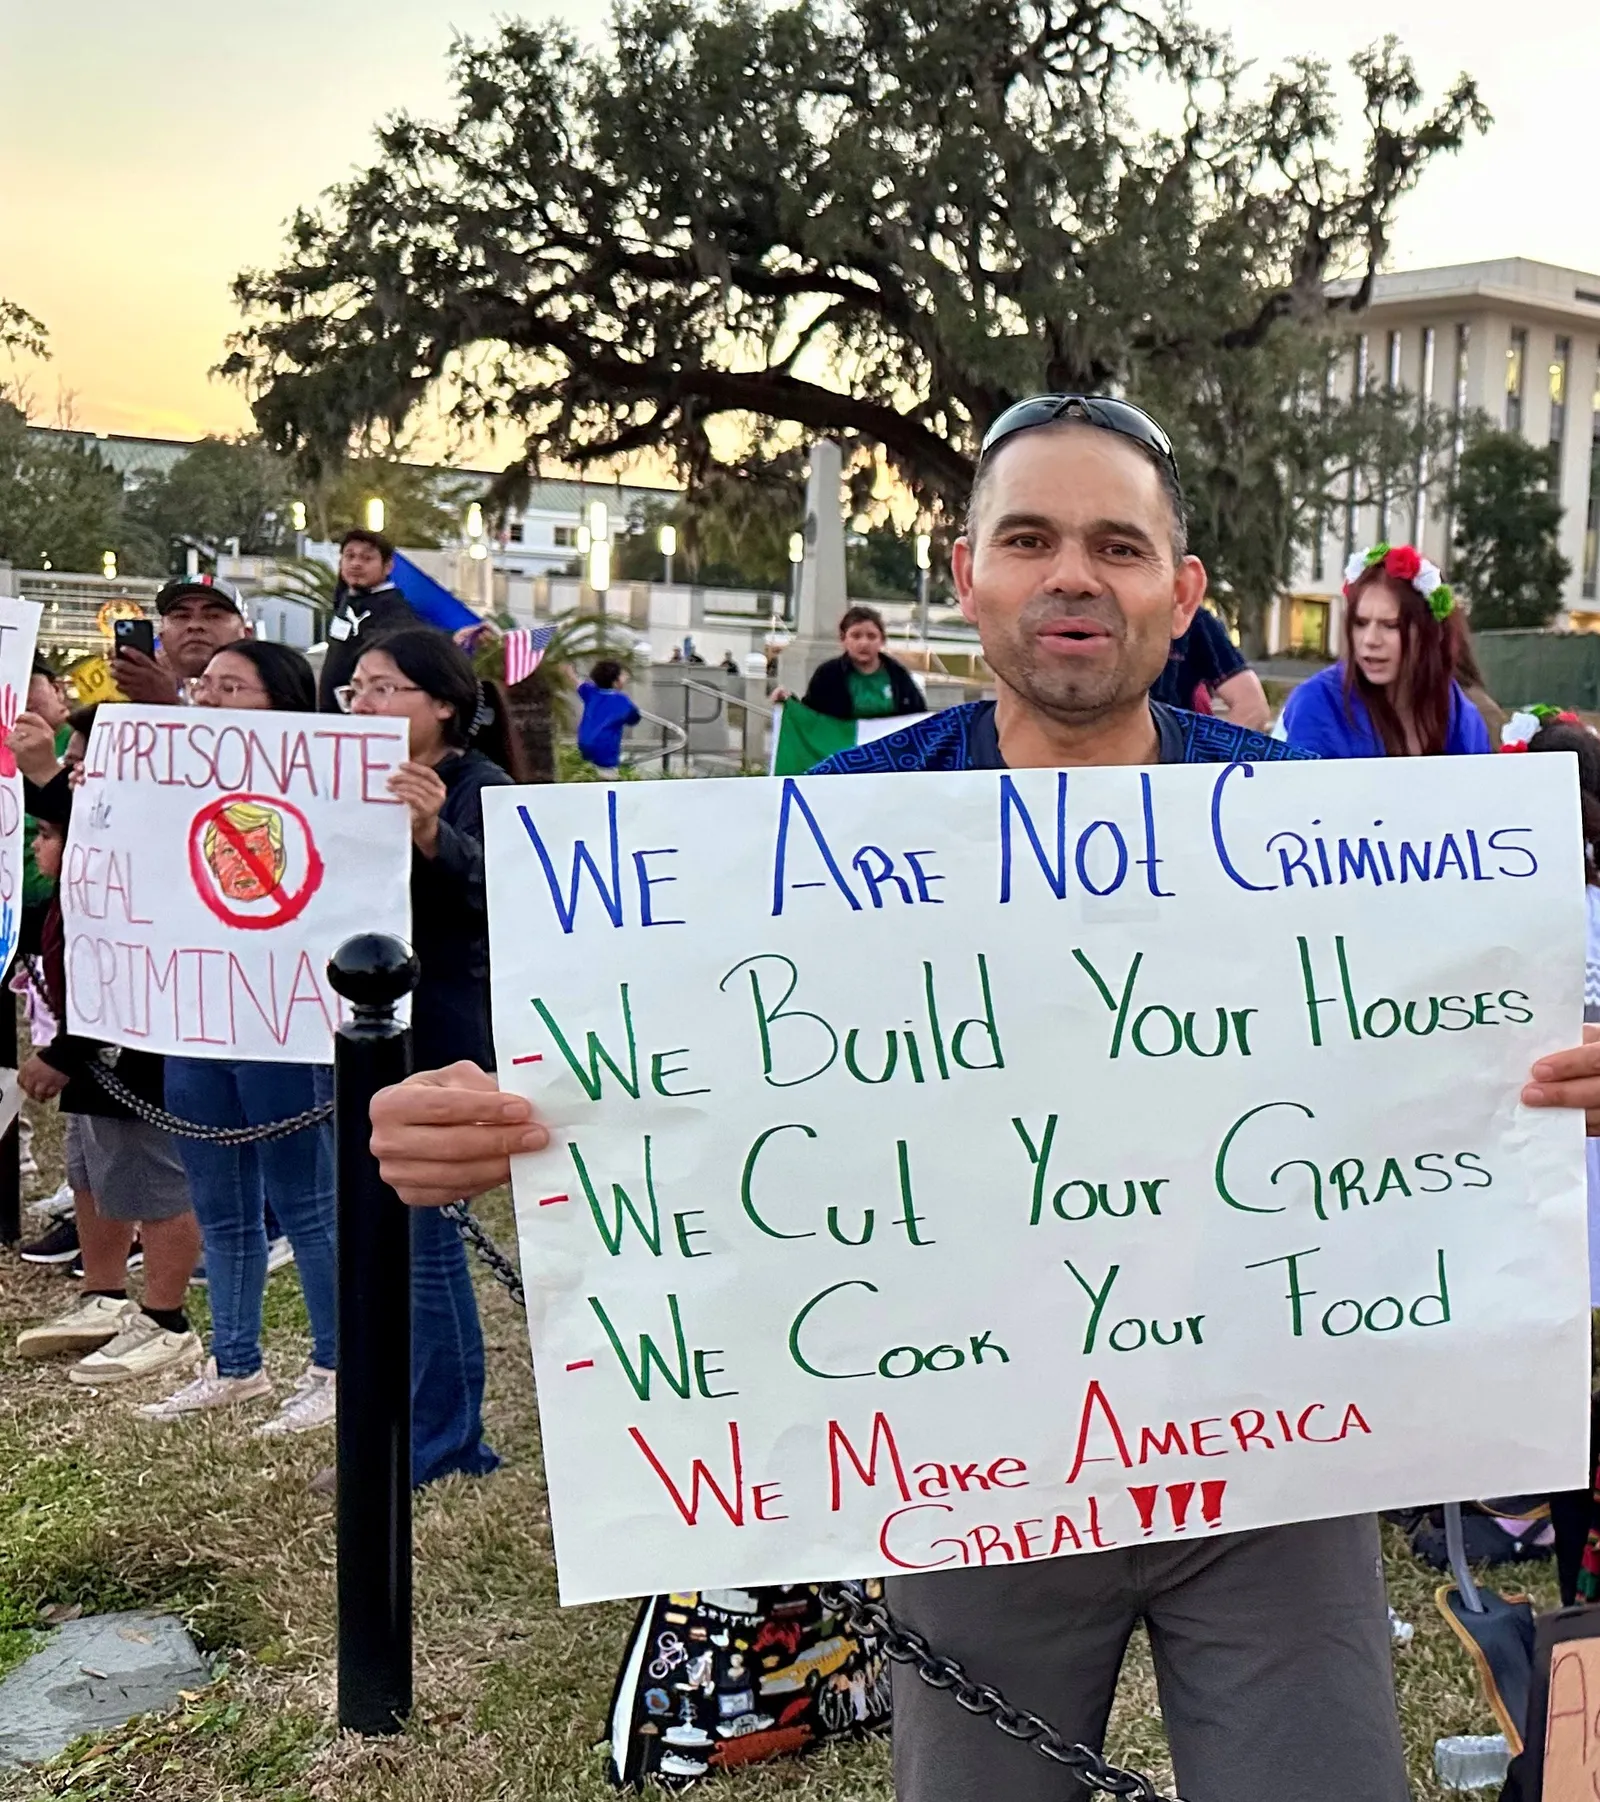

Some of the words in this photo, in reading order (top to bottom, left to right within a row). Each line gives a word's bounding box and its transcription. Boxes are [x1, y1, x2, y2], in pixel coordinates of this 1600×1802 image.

[86, 720, 403, 806] IMPRISONATE
[68, 842, 154, 926] REAL
[771, 777, 946, 916] ARE
[999, 771, 1176, 904] Not
[70, 933, 342, 1045] CRIMINA
[718, 953, 1006, 1088] Build
[1071, 947, 1259, 1060] Your
[1296, 935, 1535, 1048] HOUSES
[739, 1123, 938, 1247] Cut
[1011, 1113, 1170, 1227] Your
[1214, 1101, 1494, 1222] GRASS
[788, 1280, 1011, 1379] Cook
[1063, 1259, 1206, 1356] Your
[1244, 1246, 1452, 1337] Food
[827, 1411, 1030, 1512] Make
[1065, 1379, 1374, 1485] AMERICA
